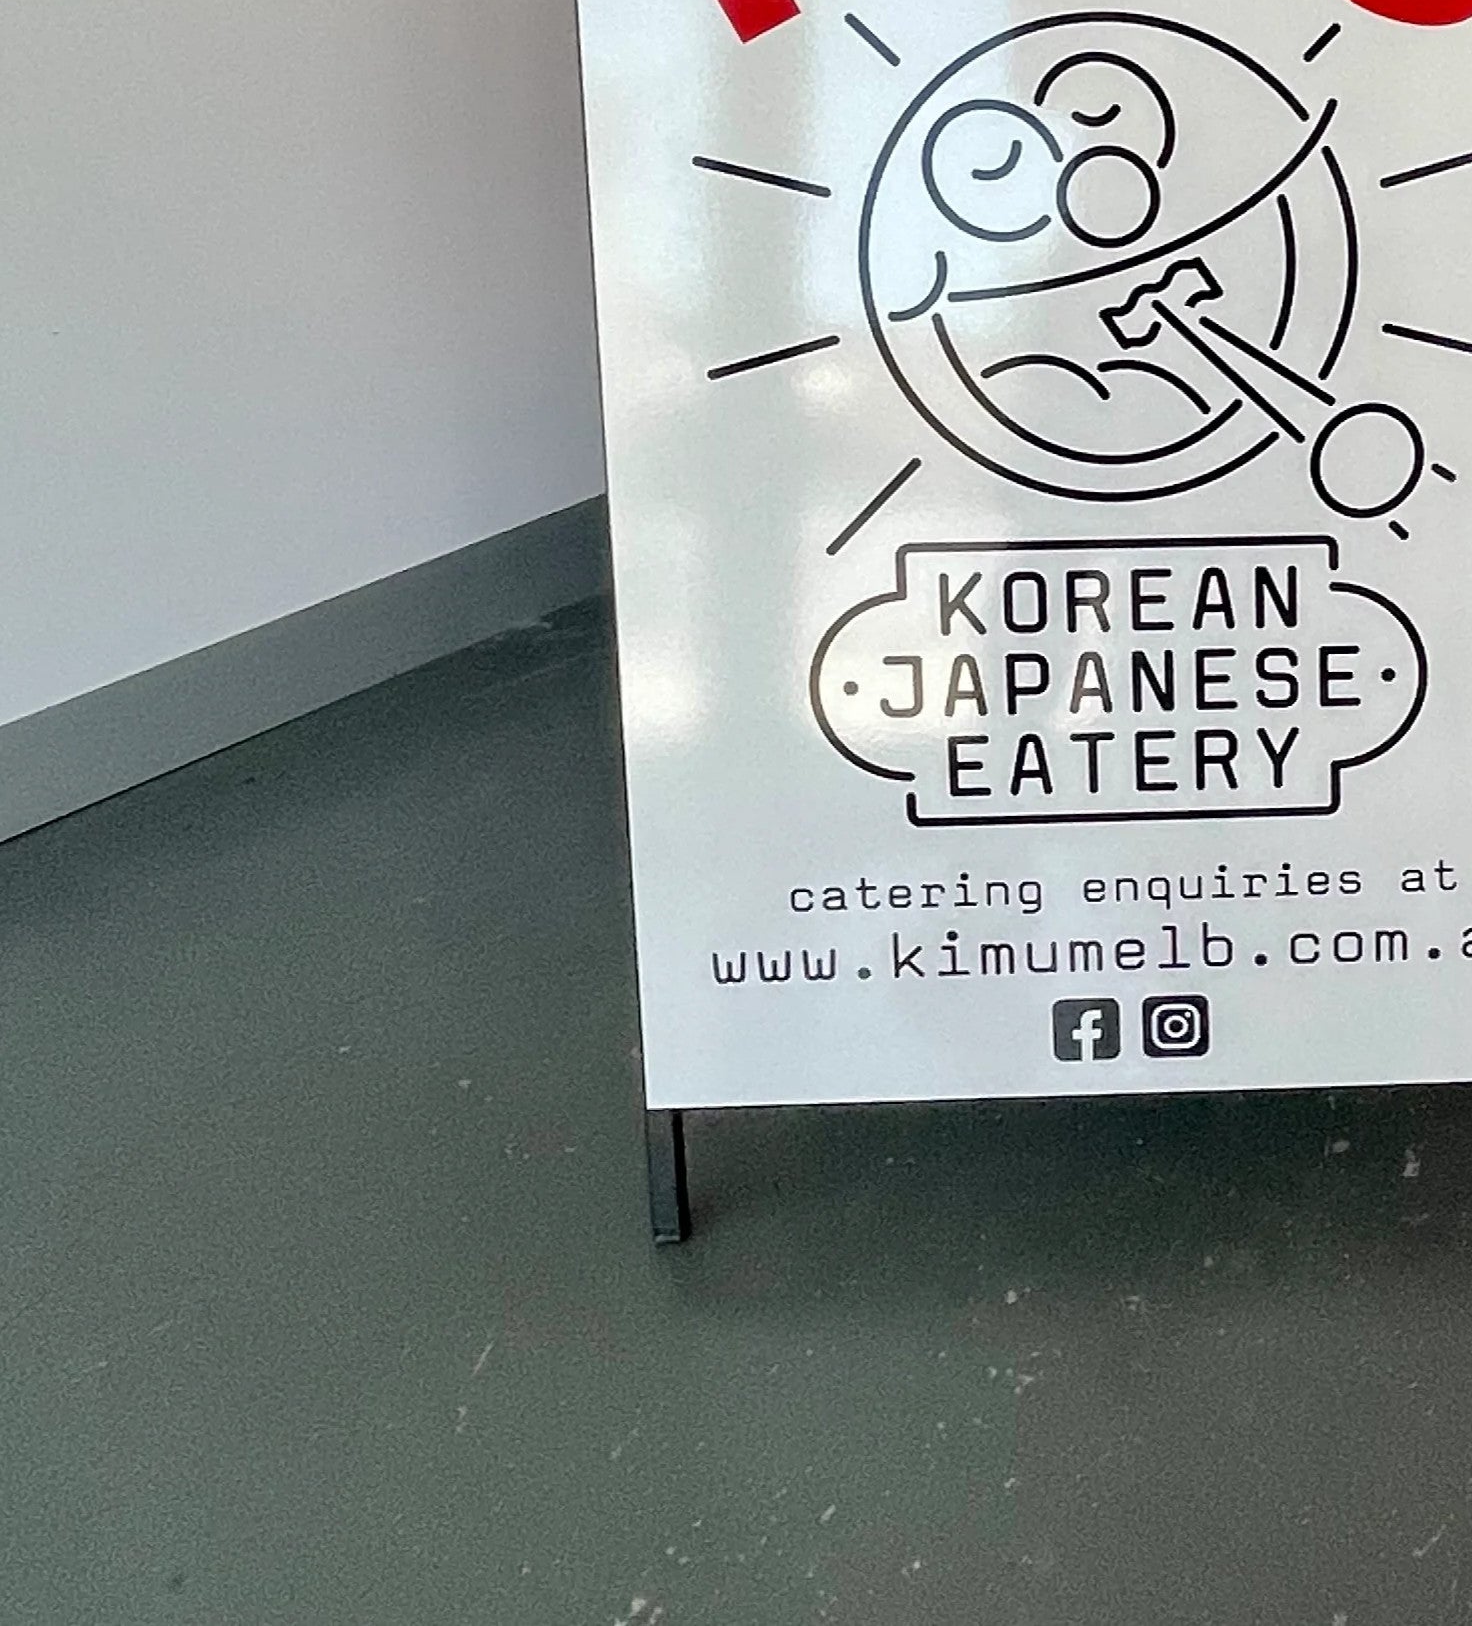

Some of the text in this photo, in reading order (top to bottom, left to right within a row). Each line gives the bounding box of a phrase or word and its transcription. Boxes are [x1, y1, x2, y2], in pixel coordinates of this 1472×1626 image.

[938, 564, 1299, 636] KOREAN
[879, 645, 1362, 719] JAPANESE
[947, 726, 1300, 798] EATERY
[789, 858, 1460, 915] catering enquiries at
